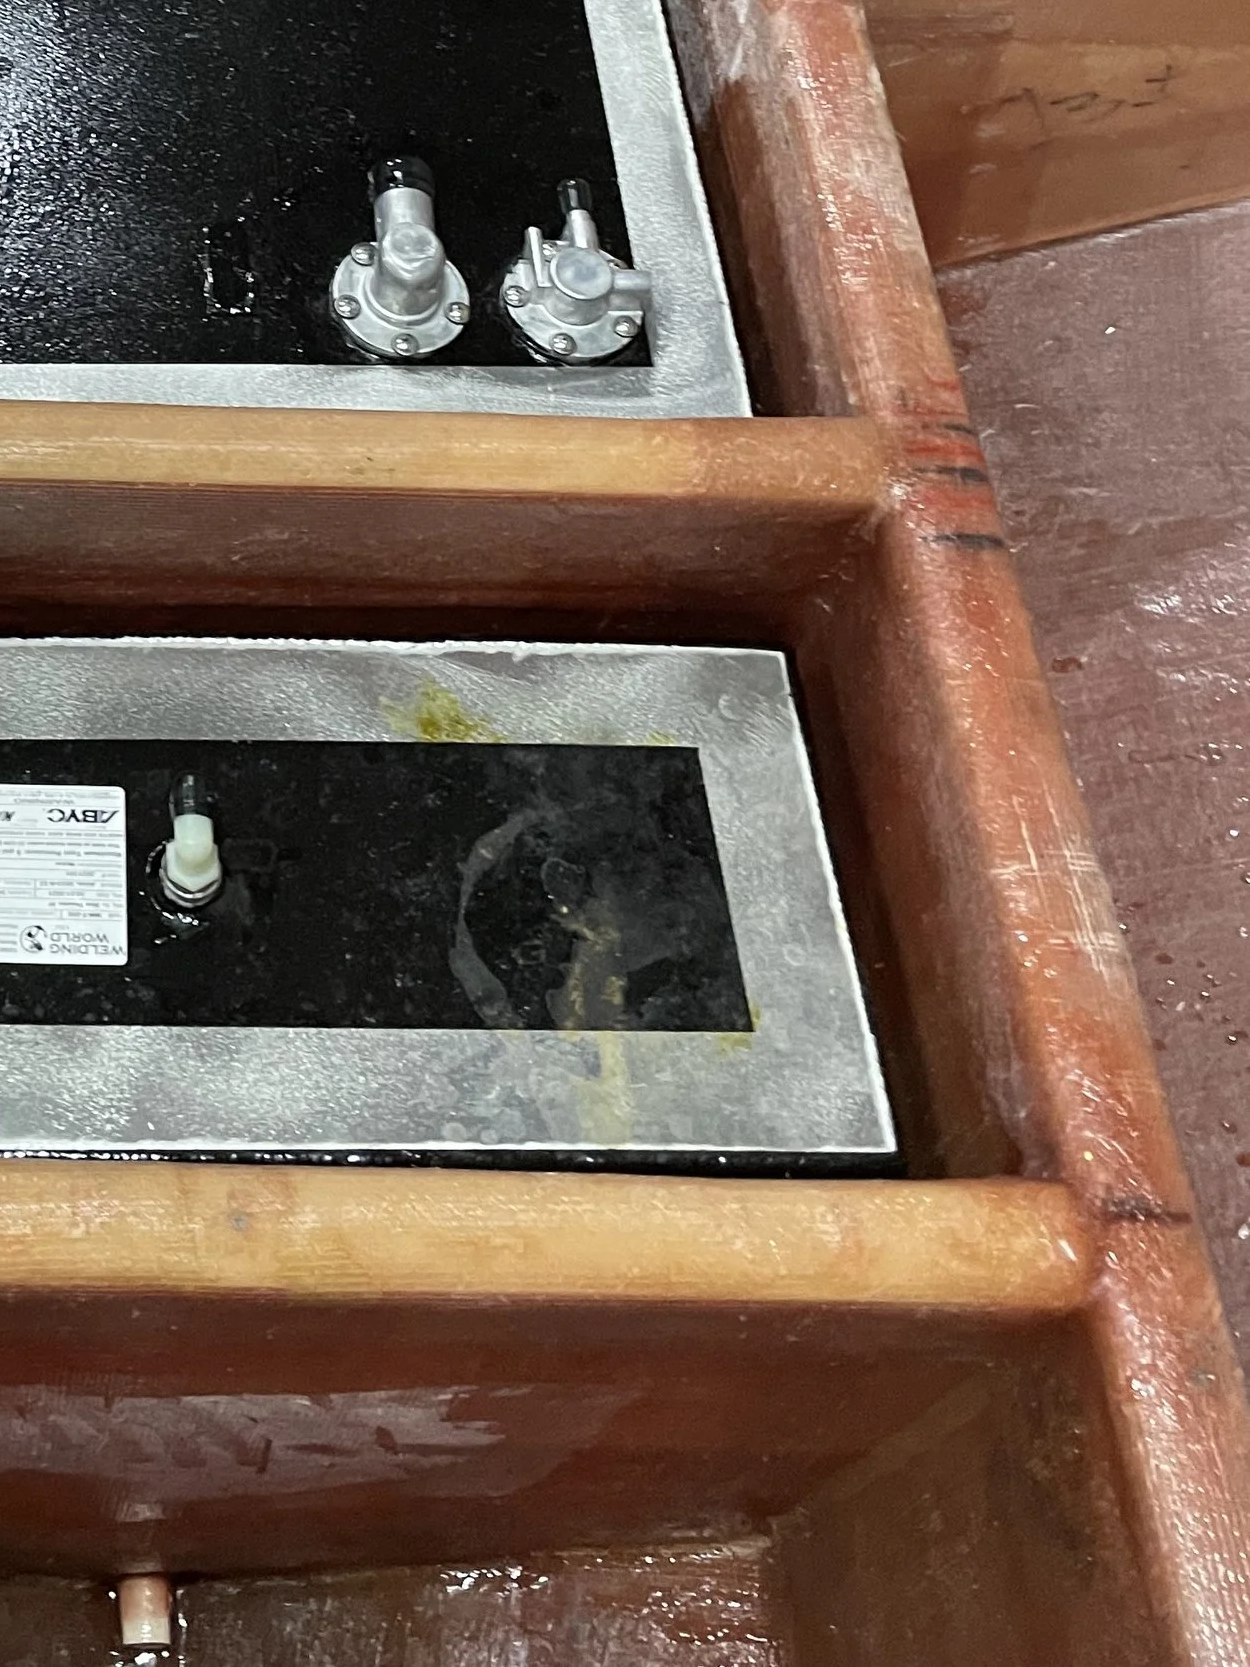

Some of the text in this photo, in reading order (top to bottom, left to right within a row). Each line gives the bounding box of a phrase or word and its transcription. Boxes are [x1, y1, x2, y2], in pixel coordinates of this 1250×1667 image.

[47, 808, 120, 824] ABYC
[50, 932, 110, 944] WORLD
[50, 944, 127, 956] WELDING
